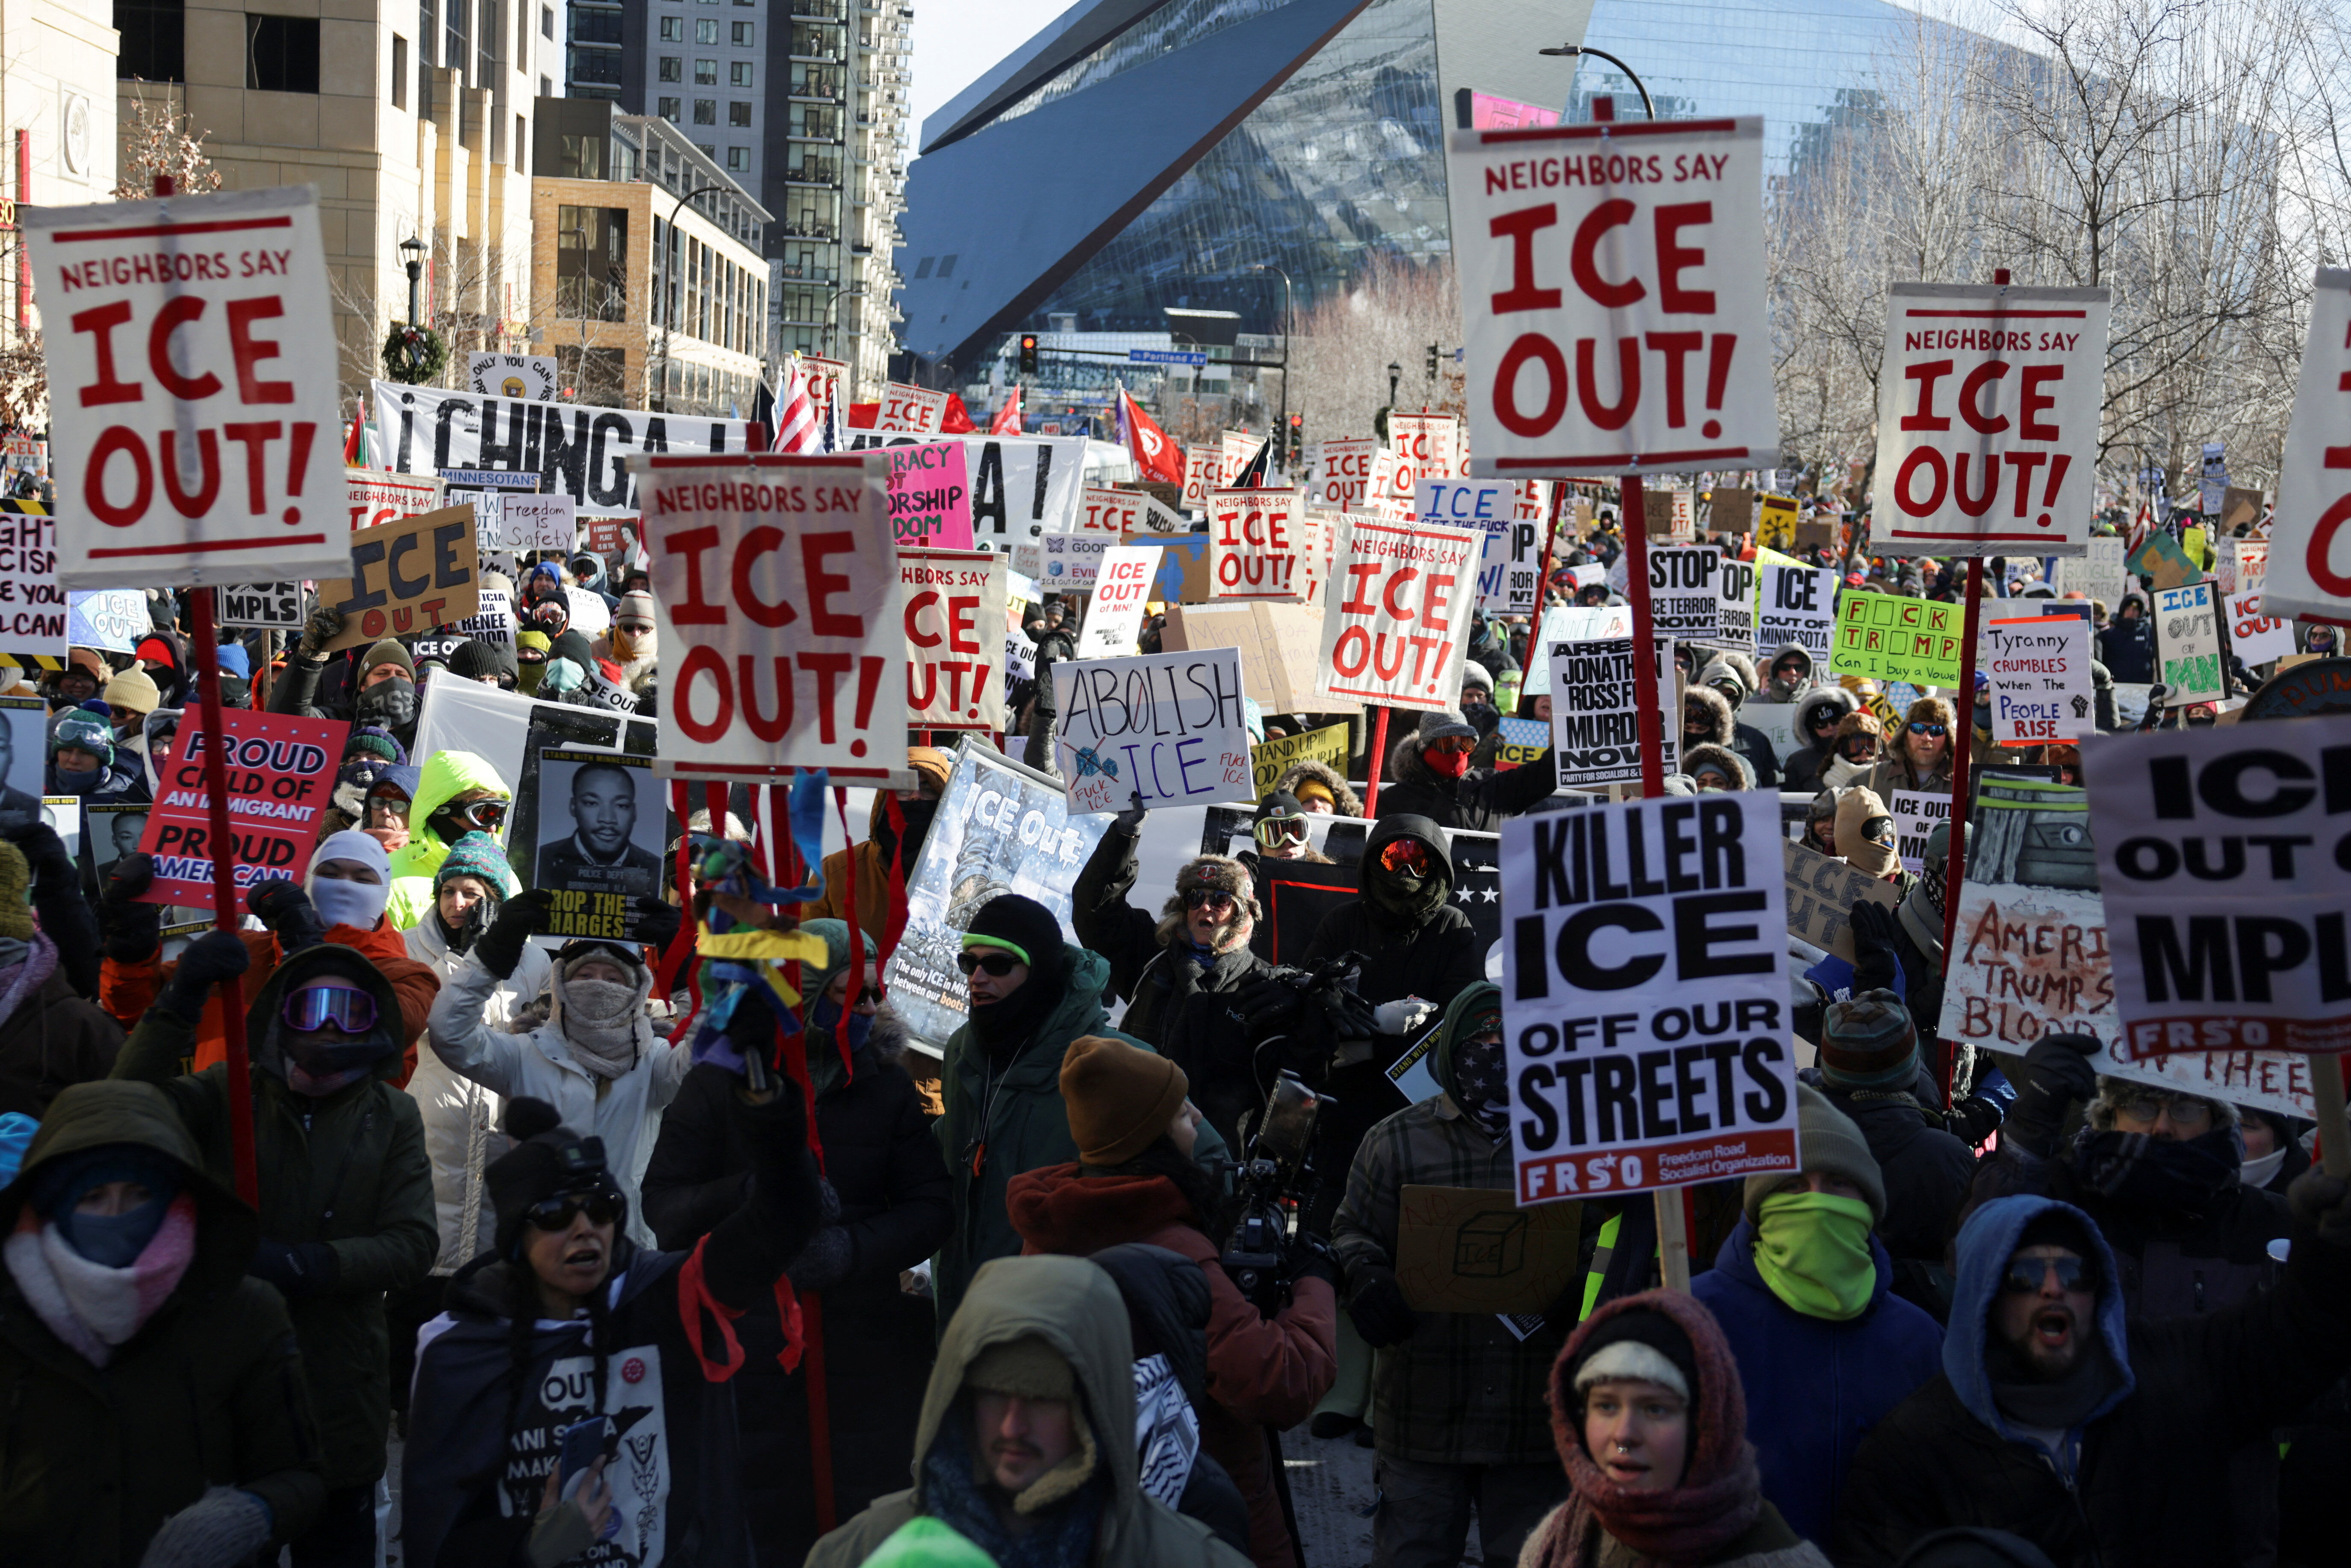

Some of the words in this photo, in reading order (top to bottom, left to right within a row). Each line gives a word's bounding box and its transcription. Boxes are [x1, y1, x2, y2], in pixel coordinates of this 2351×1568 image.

[1485, 154, 1663, 195] NEIGHBORS
[1673, 153, 1729, 181] SAY
[1490, 198, 1716, 314] ICE
[59, 253, 230, 292] NEIGHBORS
[240, 250, 292, 278] SAY
[71, 295, 295, 407] ICE
[1906, 330, 2031, 351] NEIGHBORS
[2039, 332, 2080, 352] SAY
[473, 356, 495, 375] ONLY
[504, 356, 524, 367] YOU
[533, 361, 552, 382] CAN
[1143, 353, 1187, 363] Portland
[890, 390, 926, 401] NEIGHBORS
[1493, 331, 1737, 439] OUT!
[1900, 359, 2064, 442] ICE
[885, 399, 934, 427] ICE
[1396, 433, 1446, 463] ICE
[14, 457, 39, 467] ICE
[83, 420, 317, 527] OUT!
[1326, 454, 1369, 477] ICE
[1894, 445, 2072, 528] OUT!
[411, 497, 431, 507] SAY
[504, 496, 565, 521] Freedom
[656, 483, 806, 515] NEIGHBORS
[815, 486, 862, 513] SAY
[1086, 495, 1125, 505] NEIGHBORS
[1216, 497, 1271, 508] NEIGHBORS
[1275, 498, 1292, 507] SAY
[1425, 485, 1498, 518] ICE
[536, 516, 548, 528] is
[1084, 506, 1136, 533] ICE
[1218, 512, 1289, 549] ICE
[1479, 520, 1509, 532] FUCK
[507, 527, 572, 549] Safety
[1351, 539, 1434, 562] NEIGHBORS
[1441, 550, 1466, 566] SAY
[337, 522, 470, 615] ICE
[960, 570, 990, 587] SAY
[1072, 568, 1097, 577] EVIL
[1109, 563, 1146, 580] ICE
[1219, 553, 1296, 590] OUT!
[1650, 550, 1718, 588] STOP
[2064, 563, 2118, 580] GOOGLE
[665, 525, 864, 637] ICE
[1099, 584, 1146, 601] OUT
[1776, 567, 1819, 611] ICE
[19, 583, 65, 606] YOU
[98, 594, 138, 619] ICE
[1341, 563, 1455, 632] ICE
[1669, 597, 1716, 614] TERROR
[2163, 587, 2208, 611] ICE
[226, 595, 298, 621] MPLS
[362, 599, 446, 637] OUT
[1100, 604, 1111, 612] of
[1113, 604, 1132, 612] MN!
[13, 613, 65, 637] CAN
[94, 613, 143, 638] OUT
[462, 613, 507, 631] RENEE
[1554, 619, 1595, 639] AIN'T
[1652, 616, 1716, 628] NOW!
[1762, 616, 1801, 627] OUT
[1804, 620, 1830, 629] OF
[2168, 612, 2214, 639] OUT
[413, 642, 438, 655] ICE
[1760, 628, 1827, 648] MINNESOTA
[1988, 629, 2068, 657] Tyranny
[2182, 643, 2195, 654] OF
[1011, 661, 1022, 672] OF
[1332, 625, 1453, 694] OUT!
[1835, 654, 1861, 668] Can
[1869, 658, 1877, 672] I
[1887, 660, 1909, 679] buy
[1993, 658, 2067, 673] CRUMBLES
[2043, 678, 2065, 690] The
[2165, 653, 2220, 695] MN
[673, 645, 886, 757] OUT!
[1062, 661, 1243, 739] ABOLISH
[1568, 683, 1620, 711] ROSS
[2000, 695, 2060, 719] PEOPLE
[1869, 696, 1903, 732] ICE
[2014, 720, 2058, 738] RISE
[1299, 731, 1326, 752] UP!!!
[573, 753, 592, 764] WITH
[596, 753, 640, 767] MINNESOTA
[1219, 752, 1248, 767] FUCK
[1497, 745, 1535, 763] ICE
[1121, 738, 1214, 801] ICE
[1223, 770, 1245, 785] ICE
[1562, 773, 1581, 783] PARTY
[1583, 772, 1594, 781] FOR
[1596, 769, 1629, 780] SOCIALISM
[1630, 768, 1638, 777] &
[163, 791, 197, 807] AN
[272, 777, 315, 800] OF
[1075, 779, 1111, 802] FUCK
[1088, 792, 1114, 811] ICE
[1895, 798, 1919, 814] ICE
[960, 782, 1019, 840] ICE
[1019, 811, 1085, 869] Out
[1915, 822, 1930, 833] OF
[1533, 798, 1744, 910] KILLER
[2115, 837, 2313, 881] OUT
[1785, 842, 1876, 911] ICE
[594, 893, 626, 916] THE
[1514, 891, 1775, 1002] ICE
[896, 957, 910, 974] The
[910, 967, 928, 983] only
[927, 969, 946, 987] ICE
[943, 978, 951, 990] in
[951, 981, 967, 996] MN
[893, 973, 926, 996] between
[926, 990, 940, 1001] our
[940, 992, 964, 1011] boots
[1518, 1012, 1639, 1057] OFF
[1650, 999, 1780, 1042] OUR
[1391, 1057, 1413, 1078] STAND
[1411, 1042, 1429, 1061] WITH
[1517, 1037, 1788, 1152] STREETS
[1659, 1147, 1713, 1167] Freedom
[1715, 1143, 1746, 1157] Road
[1660, 1164, 1709, 1181] Socialist
[1712, 1154, 1790, 1173] Organization
[1458, 1243, 1499, 1265] ICE
